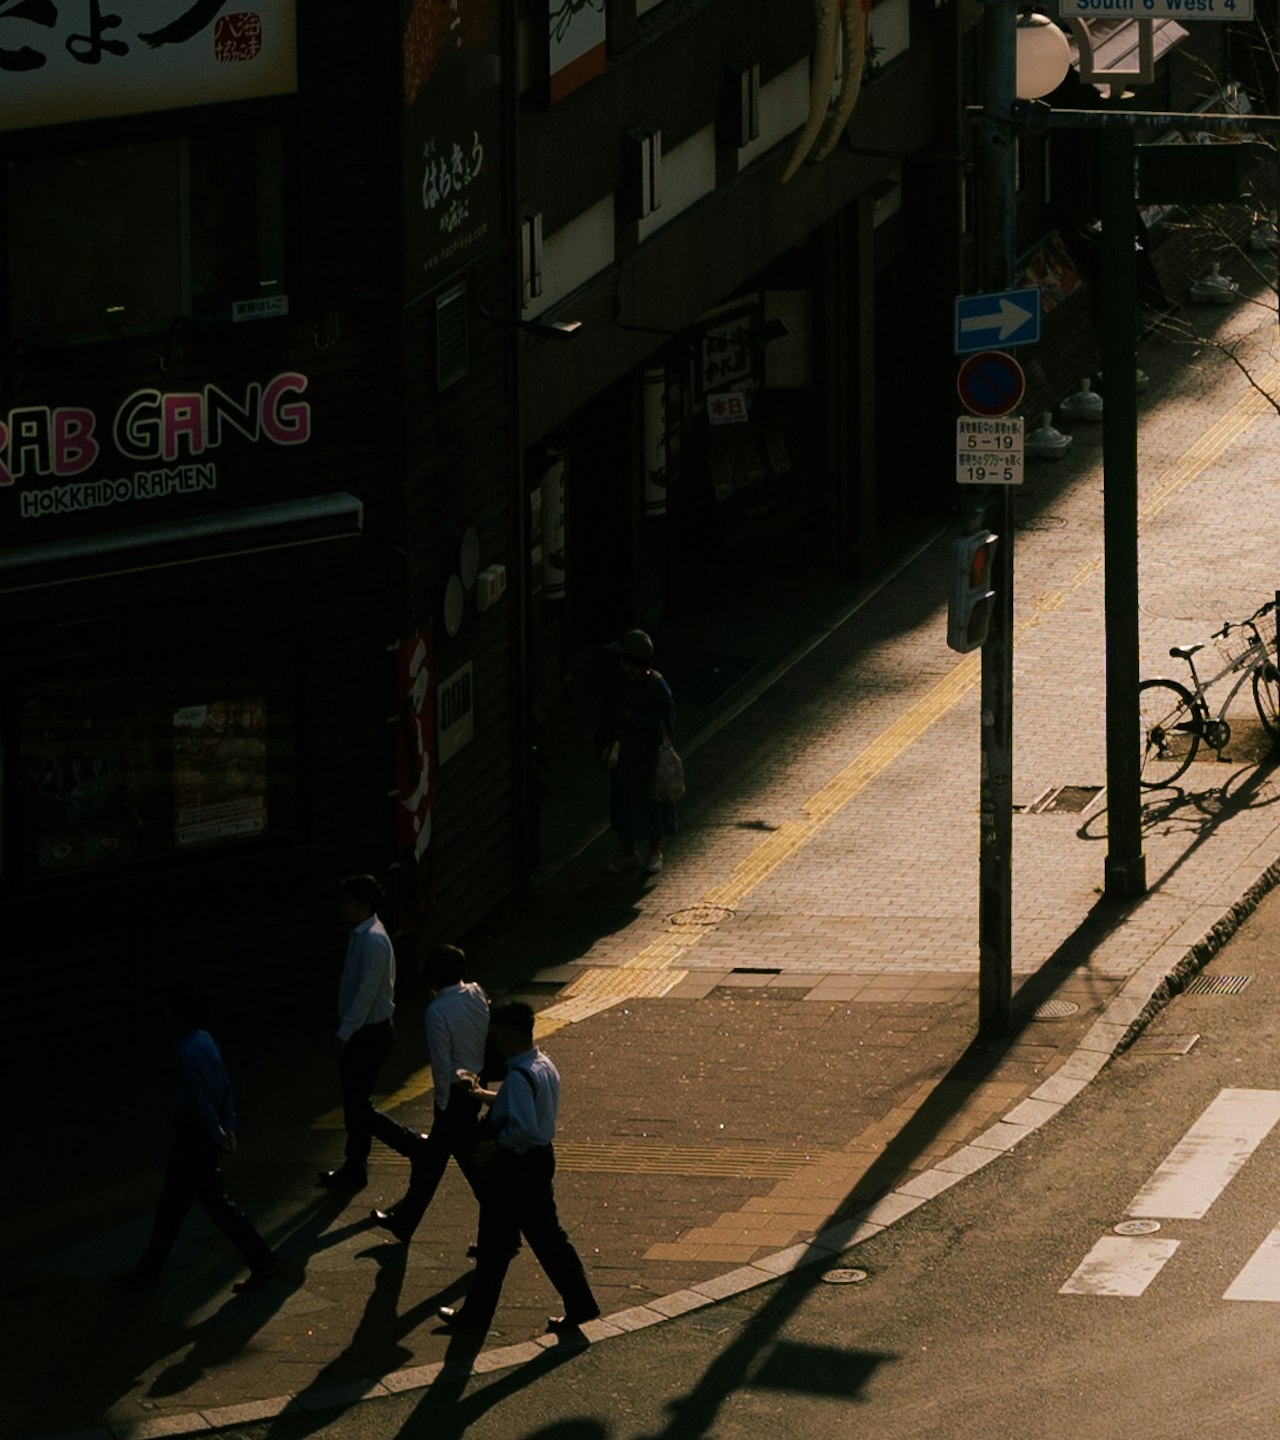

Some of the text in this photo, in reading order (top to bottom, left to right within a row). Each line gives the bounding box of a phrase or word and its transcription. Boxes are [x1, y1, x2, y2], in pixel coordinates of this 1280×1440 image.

[113, 371, 311, 461] GANG
[20, 463, 216, 517] HOKKAIDO RAMEN
